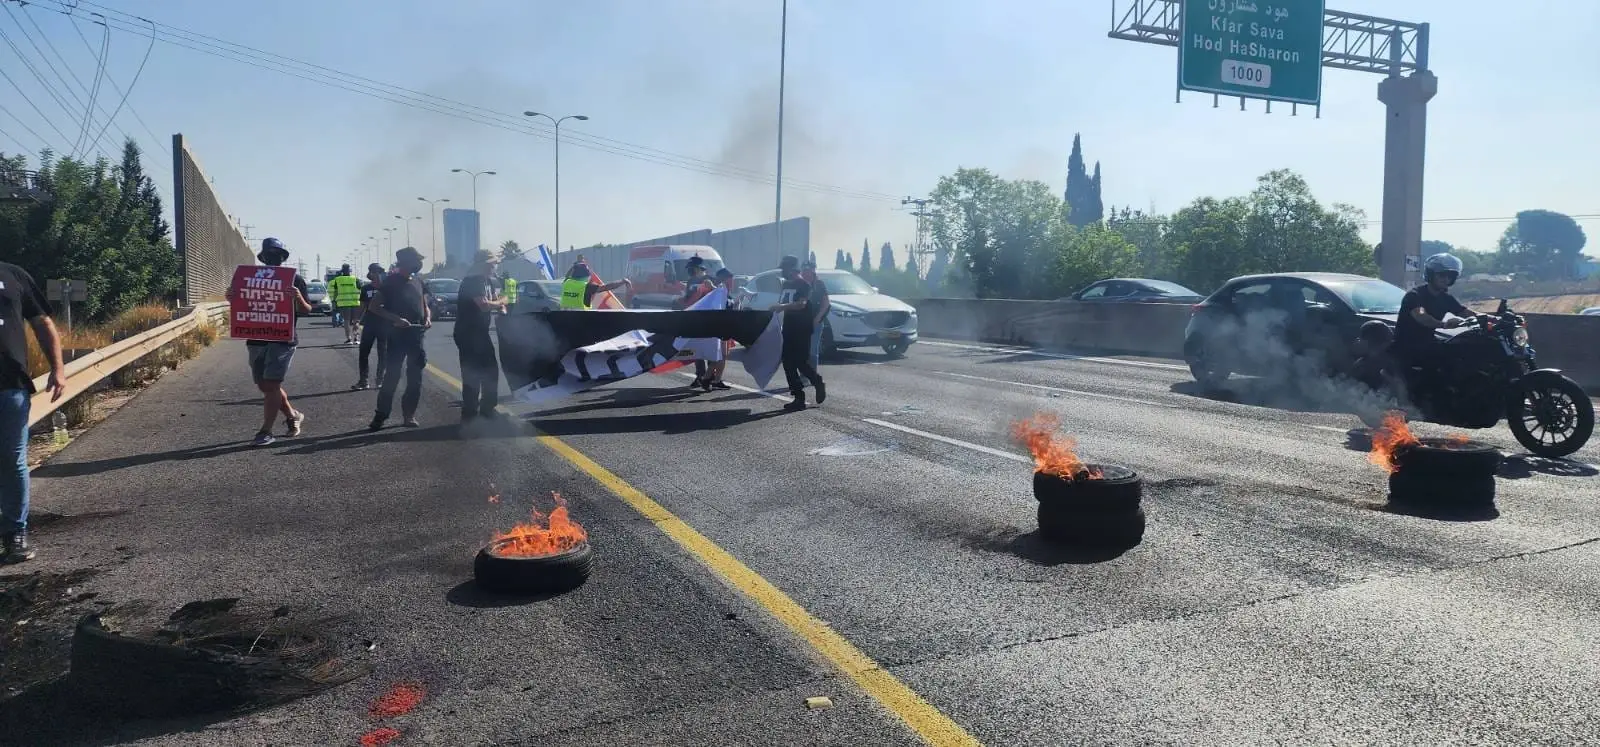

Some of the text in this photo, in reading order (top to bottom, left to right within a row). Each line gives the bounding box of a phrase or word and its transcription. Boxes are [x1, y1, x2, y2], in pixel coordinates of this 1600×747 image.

[1266, 5, 1289, 22] هود
[1211, 15, 1284, 40] Kfar Sava
[1193, 33, 1300, 63] Hod HaSharon
[1231, 66, 1262, 82] 1000
[255, 268, 276, 278] לא
[243, 277, 282, 290] תחזור
[240, 288, 285, 302] הביתה
[248, 301, 276, 312] לפני
[236, 311, 289, 324] החטופים
